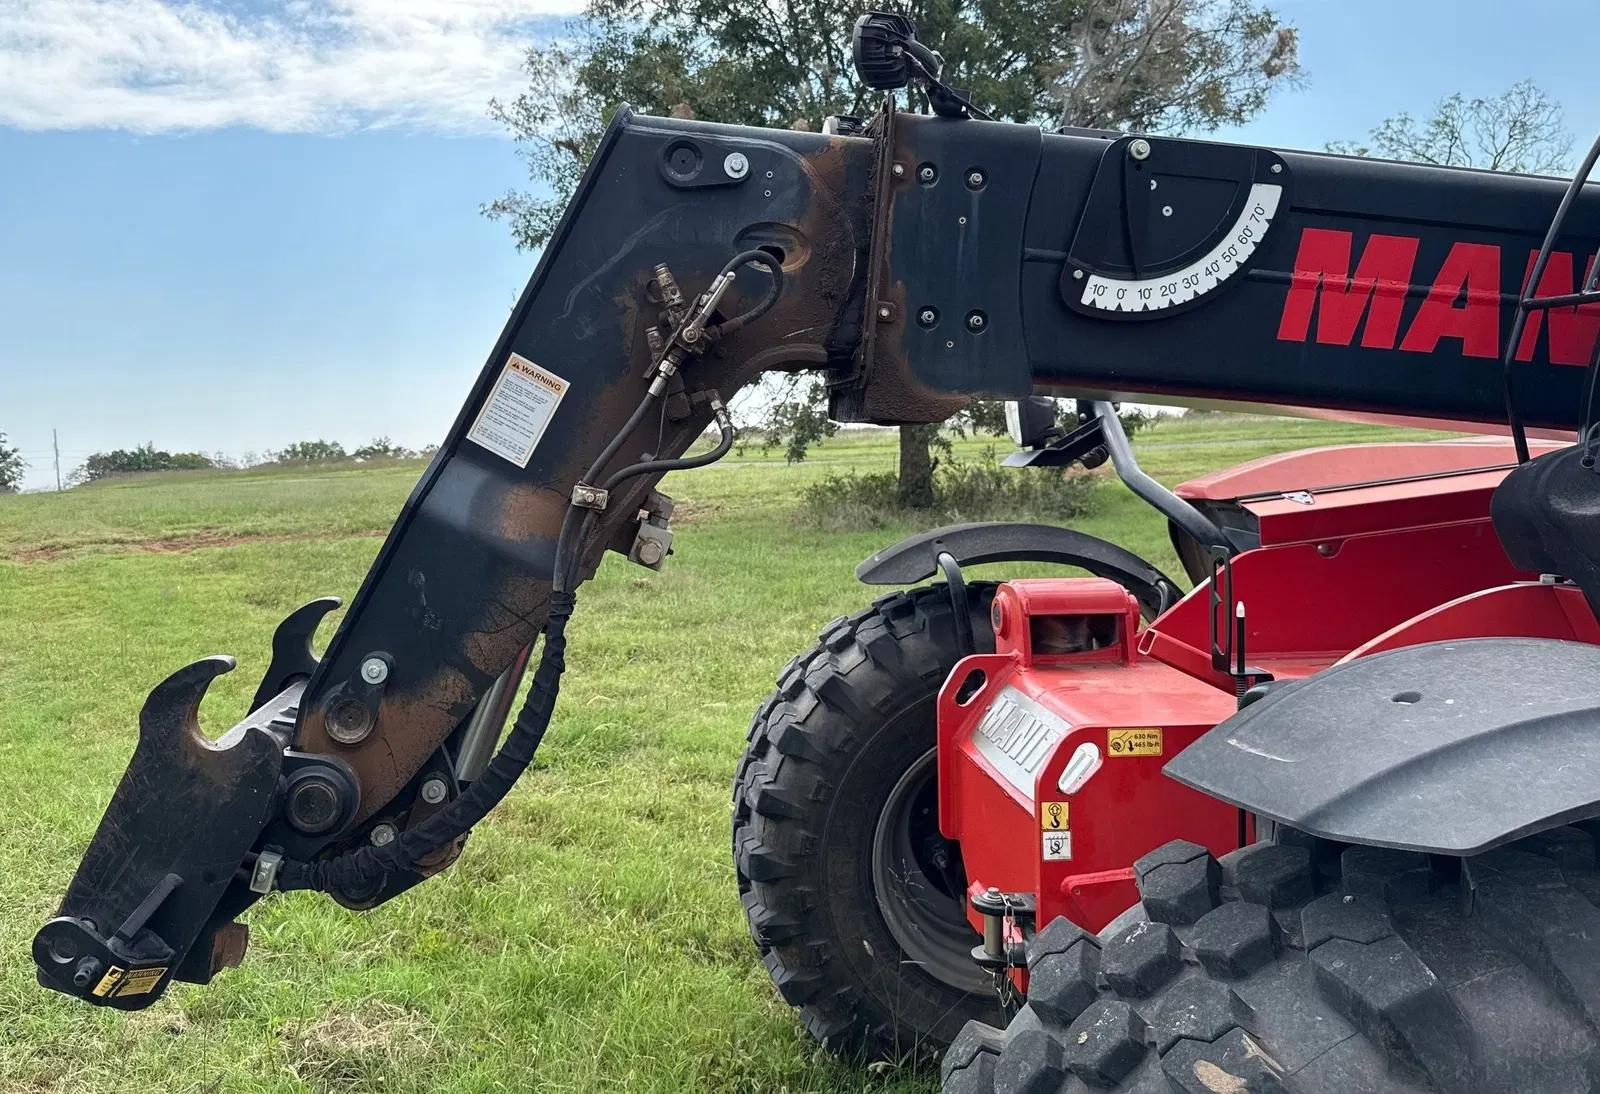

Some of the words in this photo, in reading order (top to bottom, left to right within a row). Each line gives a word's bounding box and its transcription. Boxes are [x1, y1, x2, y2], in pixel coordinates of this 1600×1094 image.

[1137, 287, 1153, 300] 10°
[1160, 282, 1178, 297] 20°
[1181, 272, 1199, 290] 30°
[1204, 259, 1220, 277] 40°
[1221, 244, 1238, 263] 50°
[1237, 225, 1253, 245] 60°
[1249, 203, 1265, 224] 70°
[521, 365, 562, 391] WARNING
